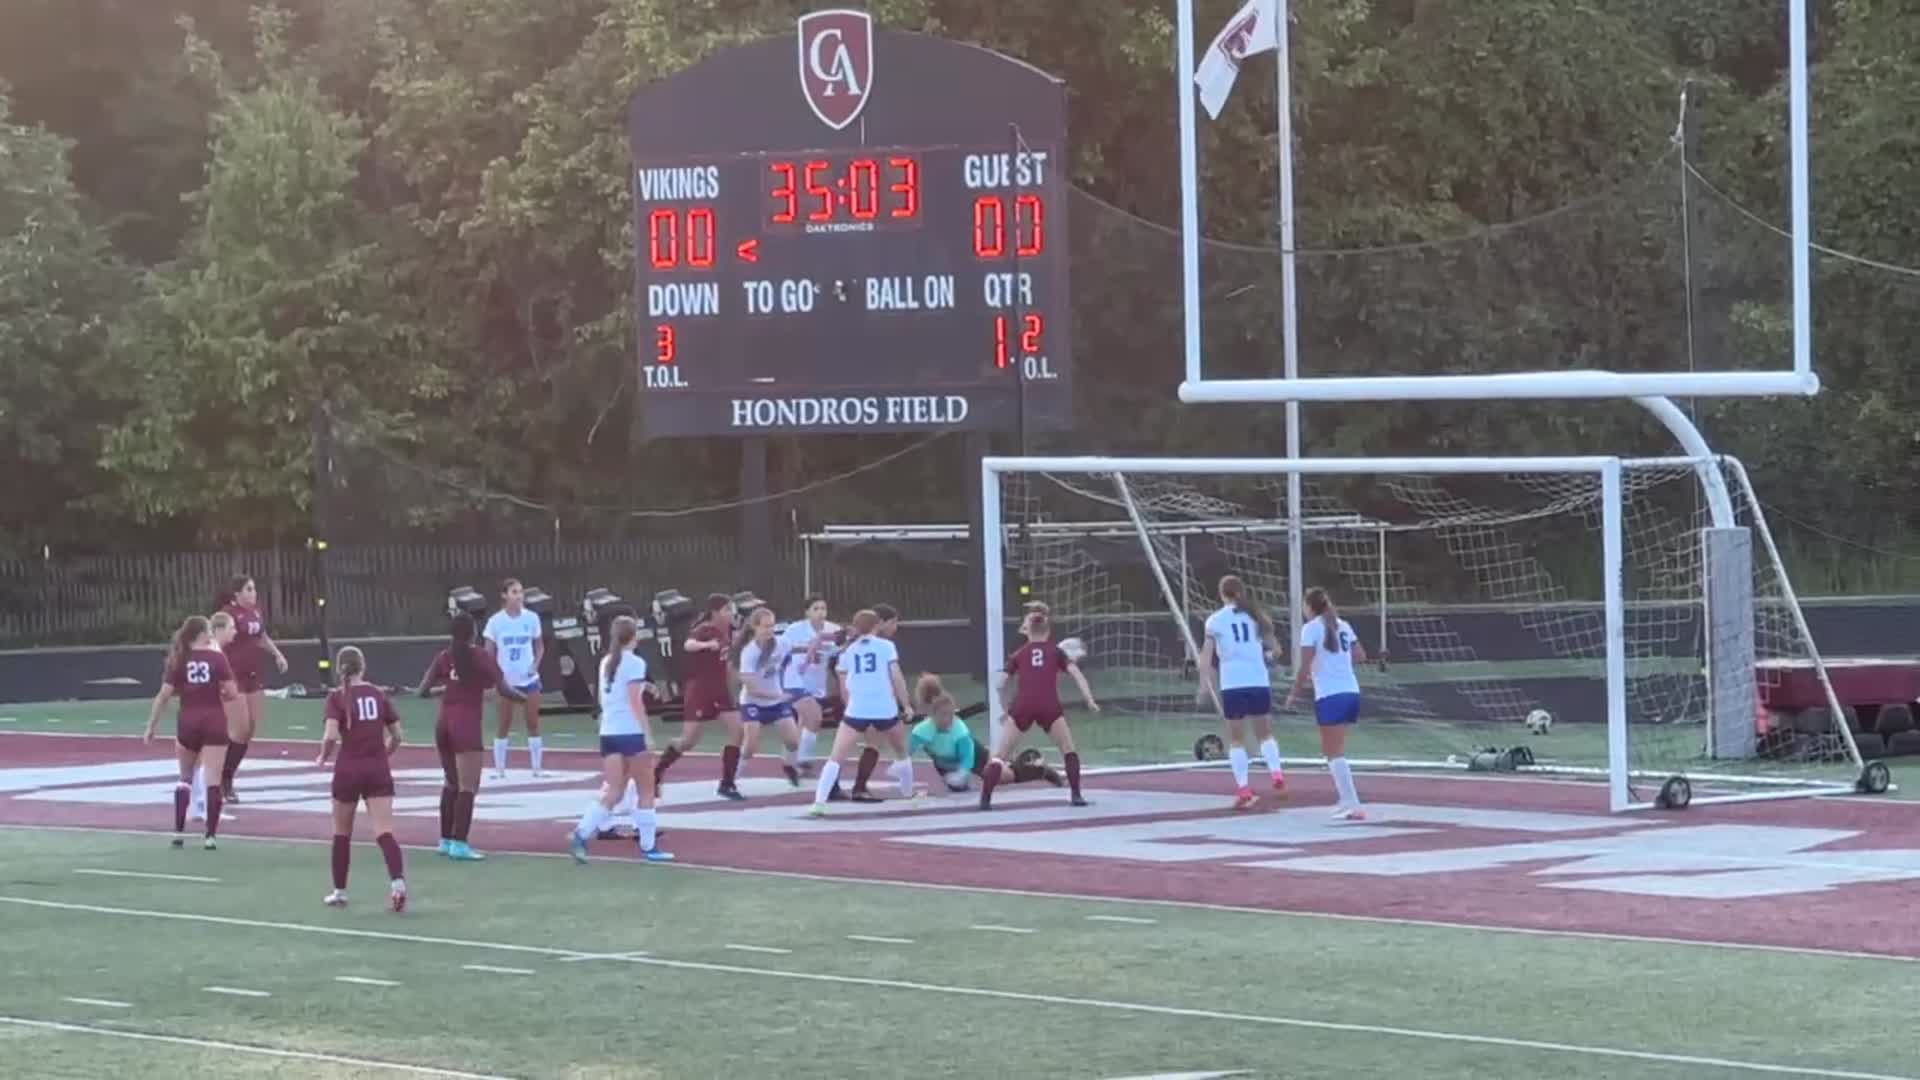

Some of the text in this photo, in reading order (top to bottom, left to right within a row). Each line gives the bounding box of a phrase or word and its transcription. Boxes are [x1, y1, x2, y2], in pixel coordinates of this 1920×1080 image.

[639, 165, 719, 200] VIKINGS
[965, 152, 1047, 188] GUEST
[768, 158, 919, 222] 35:03
[649, 208, 714, 267] 00
[974, 195, 1042, 257] 00
[648, 283, 719, 316] DOWN
[743, 278, 814, 313] TO GO
[866, 275, 954, 310] BALL ON
[984, 273, 1033, 307] QTR
[657, 325, 674, 362] 3
[1022, 315, 1041, 352] 2
[643, 365, 688, 388] T.O.L.
[731, 396, 968, 426] HONDROS FIELD
[1231, 623, 1249, 643] 11
[186, 661, 210, 683] 23
[854, 652, 877, 673] 13
[1031, 648, 1045, 667] 2
[356, 697, 379, 721] 10
